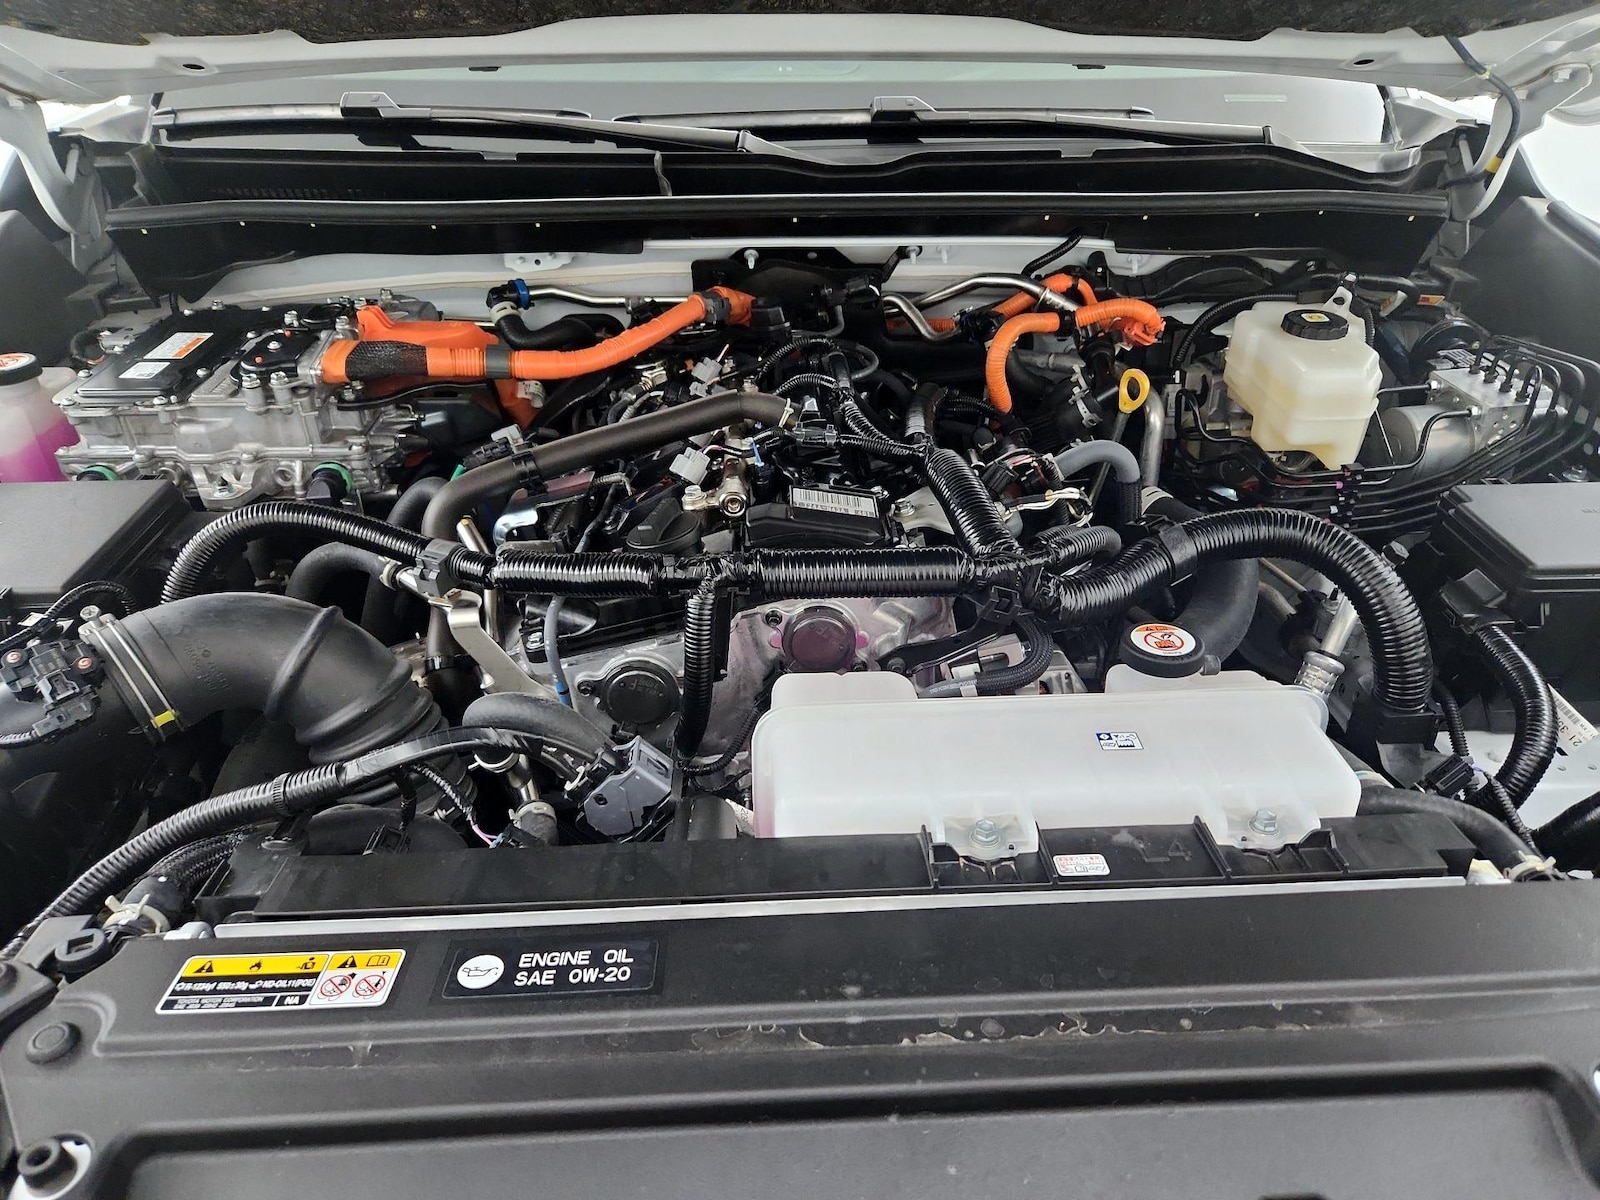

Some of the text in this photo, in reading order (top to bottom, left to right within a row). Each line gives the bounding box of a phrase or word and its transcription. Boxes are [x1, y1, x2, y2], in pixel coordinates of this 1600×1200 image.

[519, 949, 634, 968] ENGINE OIL
[514, 967, 631, 987] SAE 0W-20
[284, 996, 300, 1005] NA
